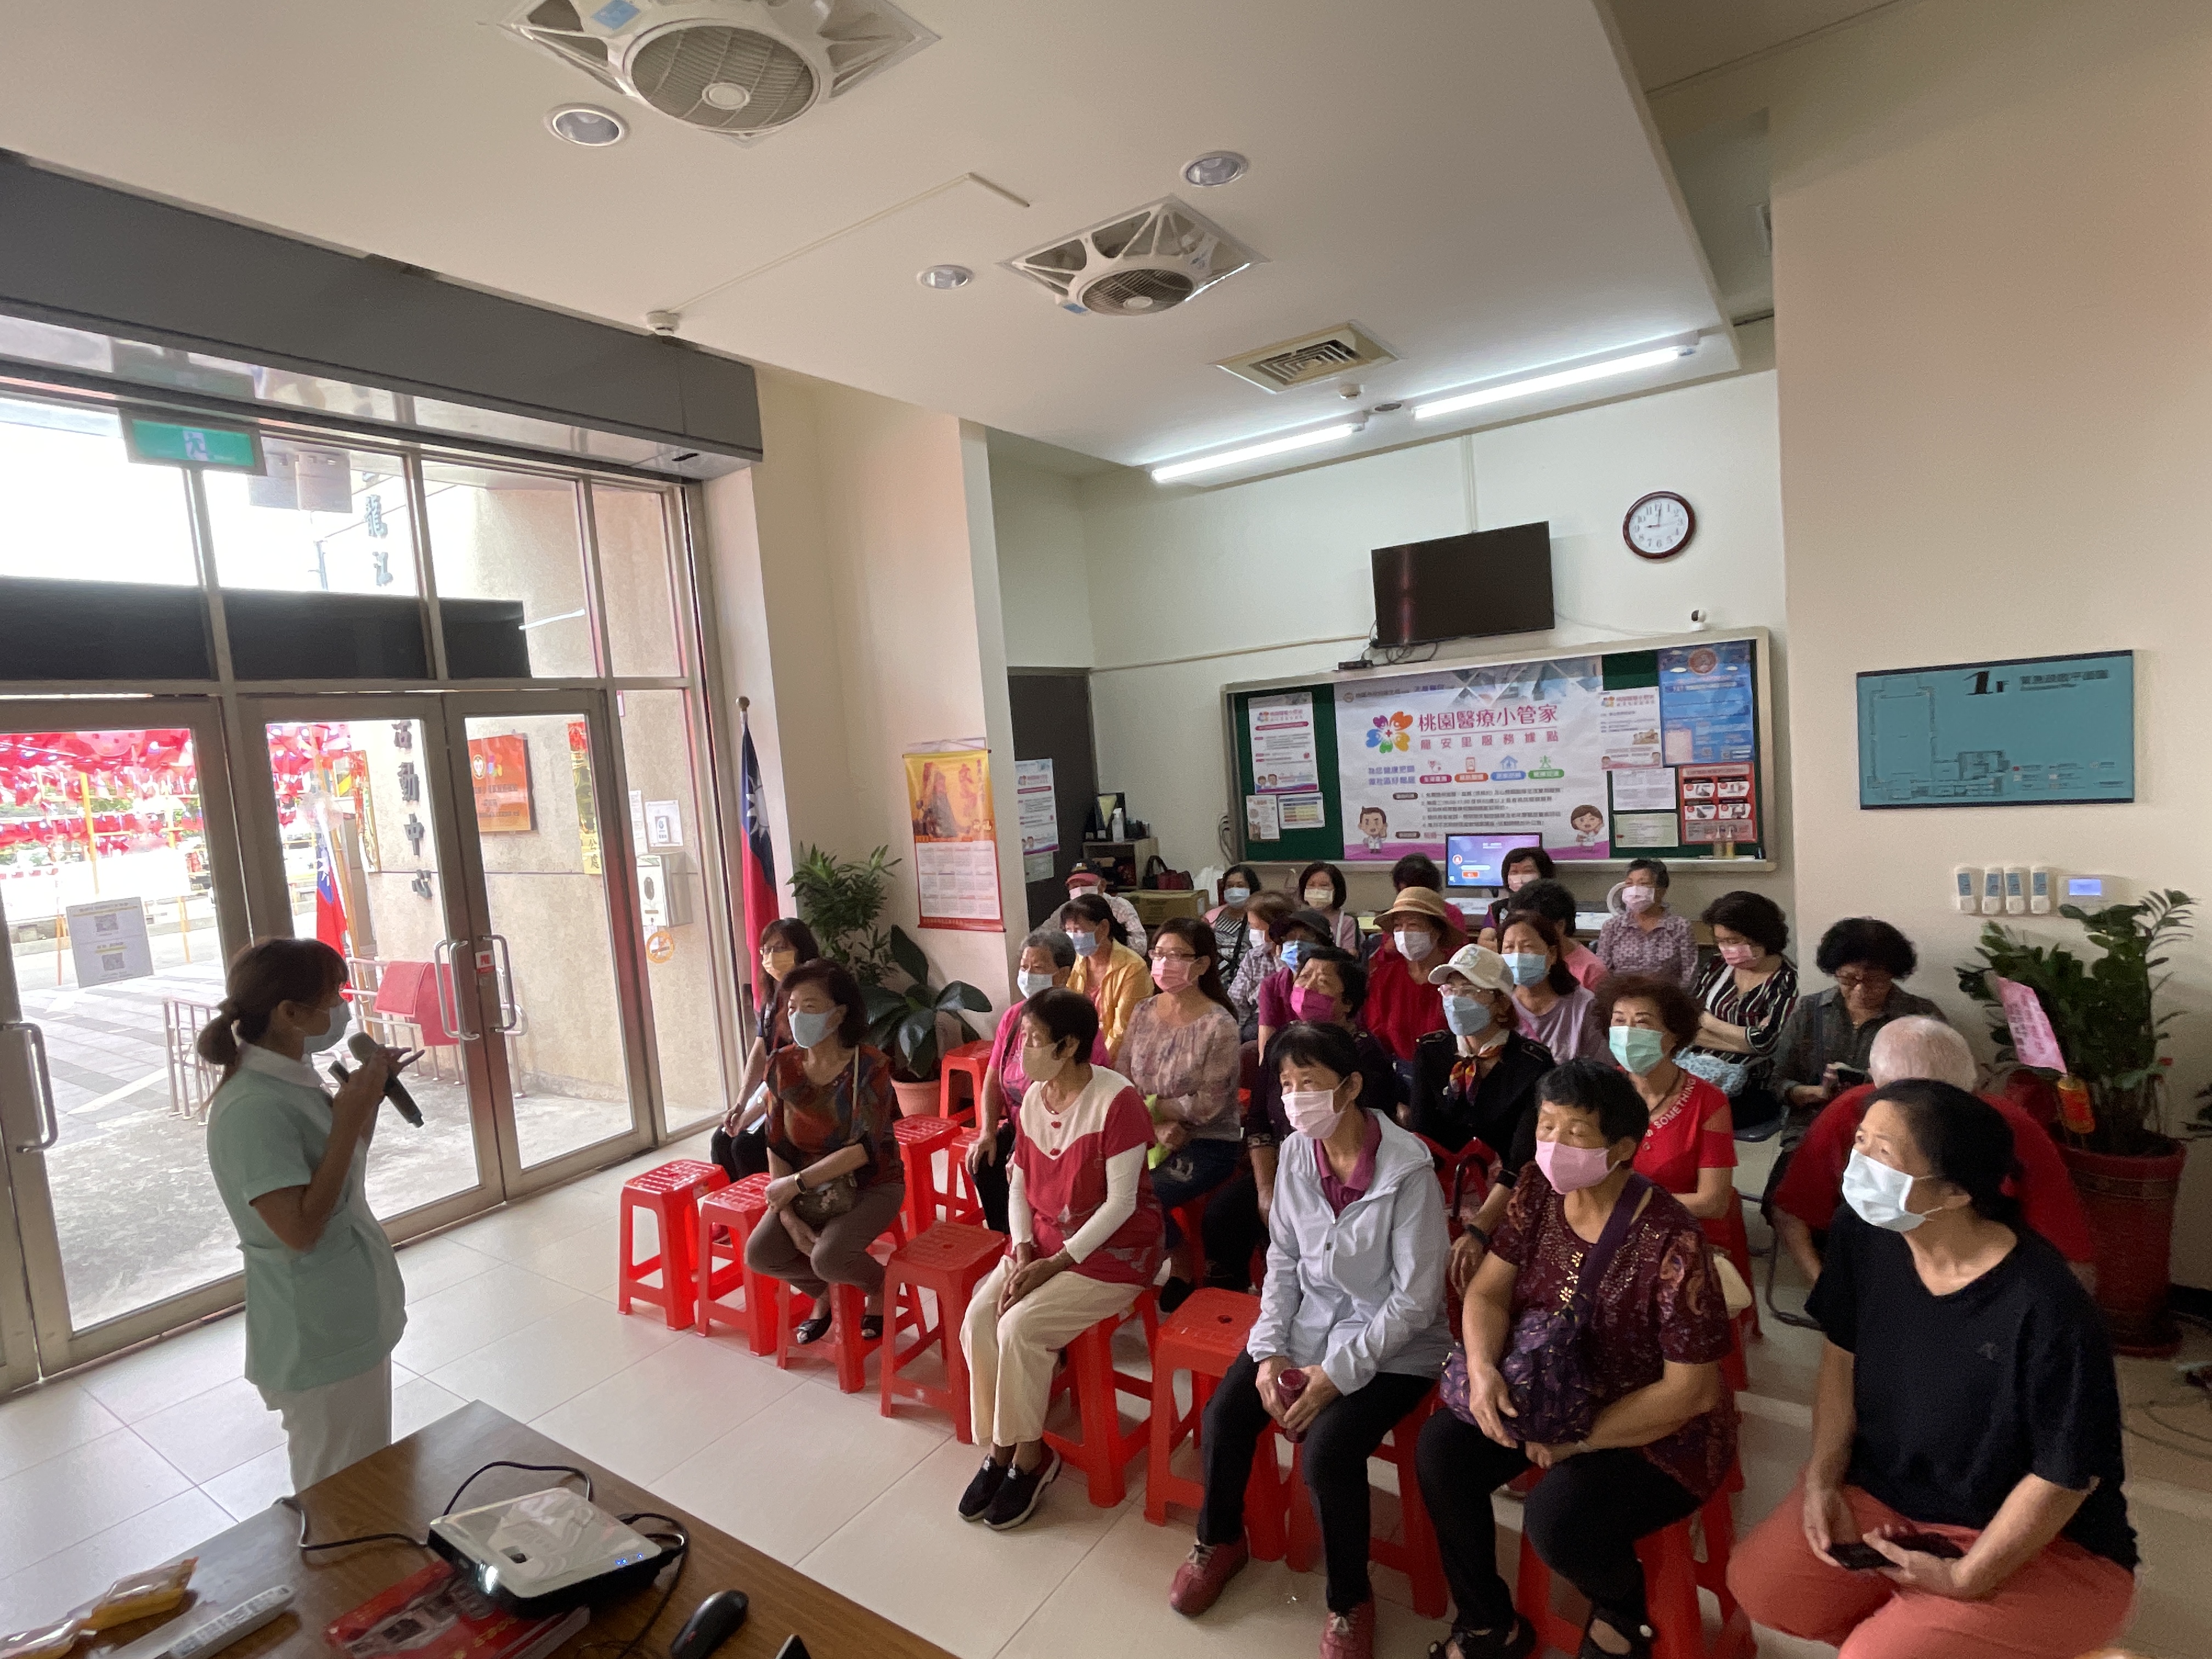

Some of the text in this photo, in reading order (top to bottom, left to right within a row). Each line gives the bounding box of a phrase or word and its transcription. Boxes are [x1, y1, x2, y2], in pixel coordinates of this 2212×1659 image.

[1419, 703, 1558, 731] 桃園醫療小管家
[1420, 730, 1559, 751] 龍安里服務據點
[1654, 1077, 1697, 1129] SOMETHING
